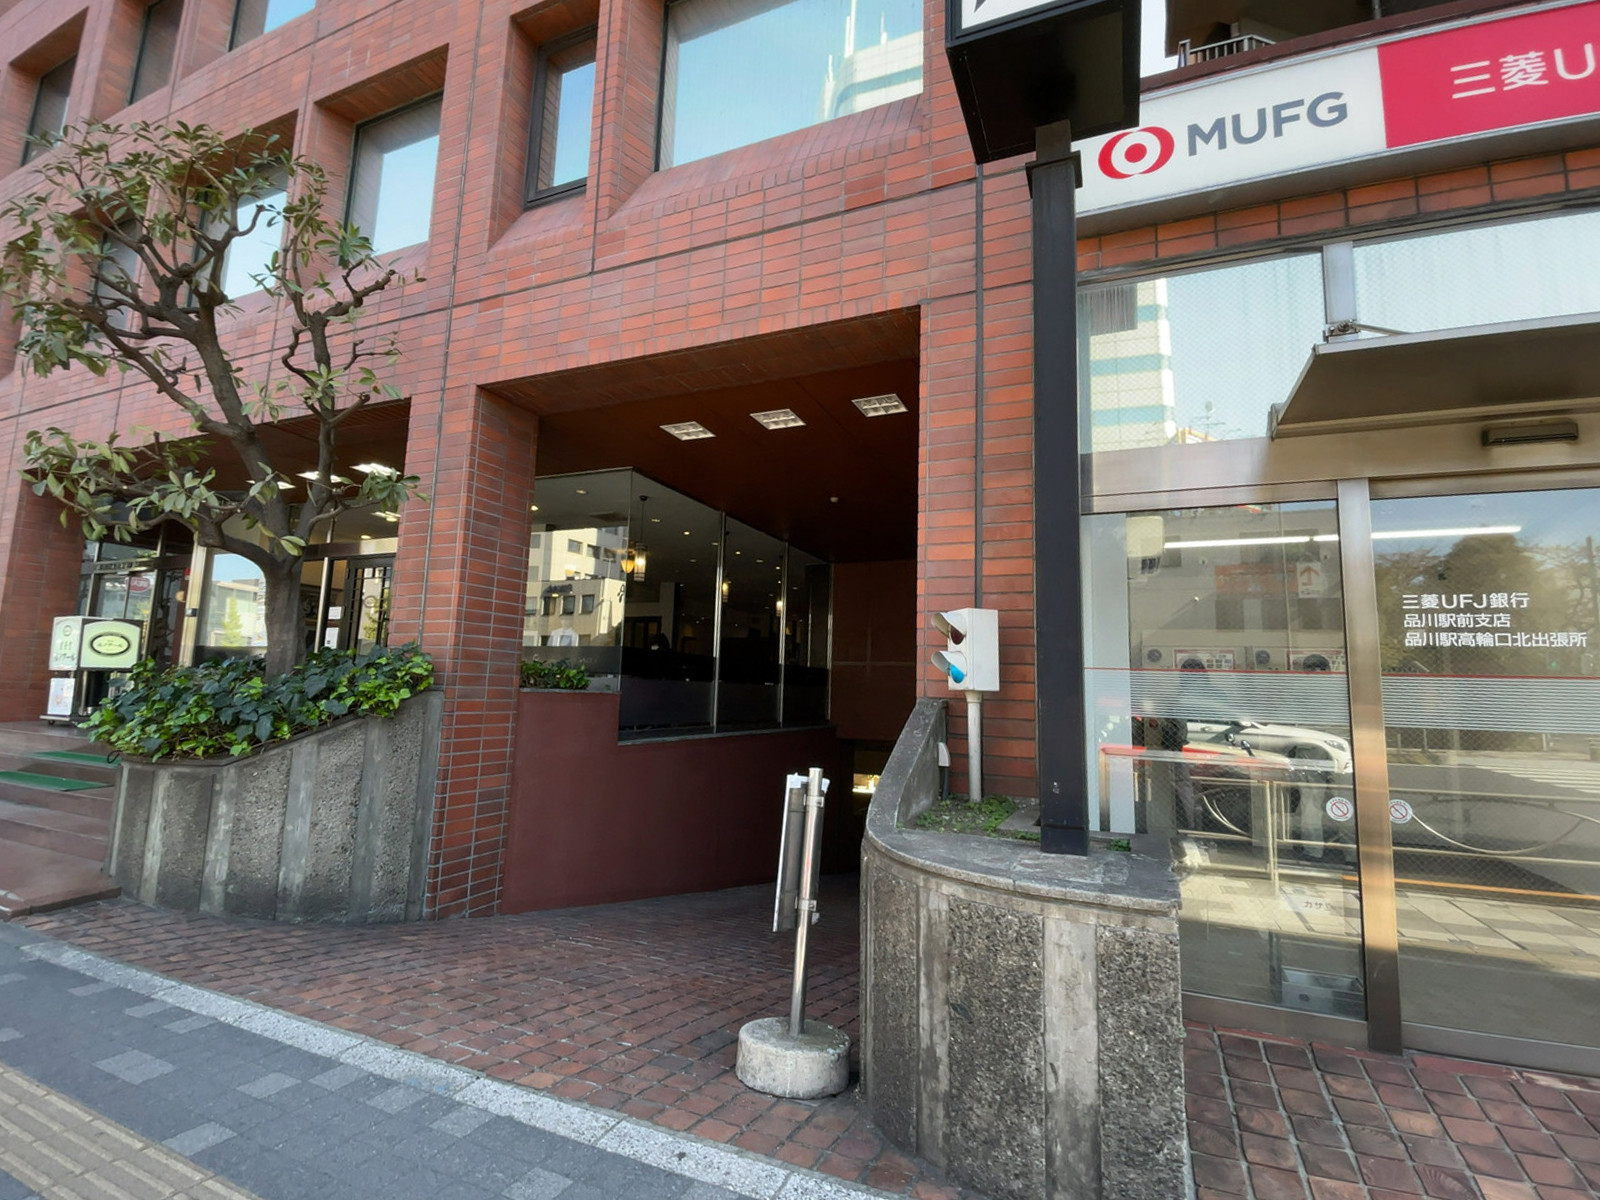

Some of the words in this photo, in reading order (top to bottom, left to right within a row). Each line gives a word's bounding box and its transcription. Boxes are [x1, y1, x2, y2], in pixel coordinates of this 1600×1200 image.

[1450, 42, 1597, 99] 三菱U
[1187, 91, 1348, 157] MUFG
[1402, 592, 1530, 609] 三菱UFJ銀行
[1404, 613, 1511, 628] 品川駅前支店
[1405, 632, 1588, 648] 品川駅高輪口北出張所
